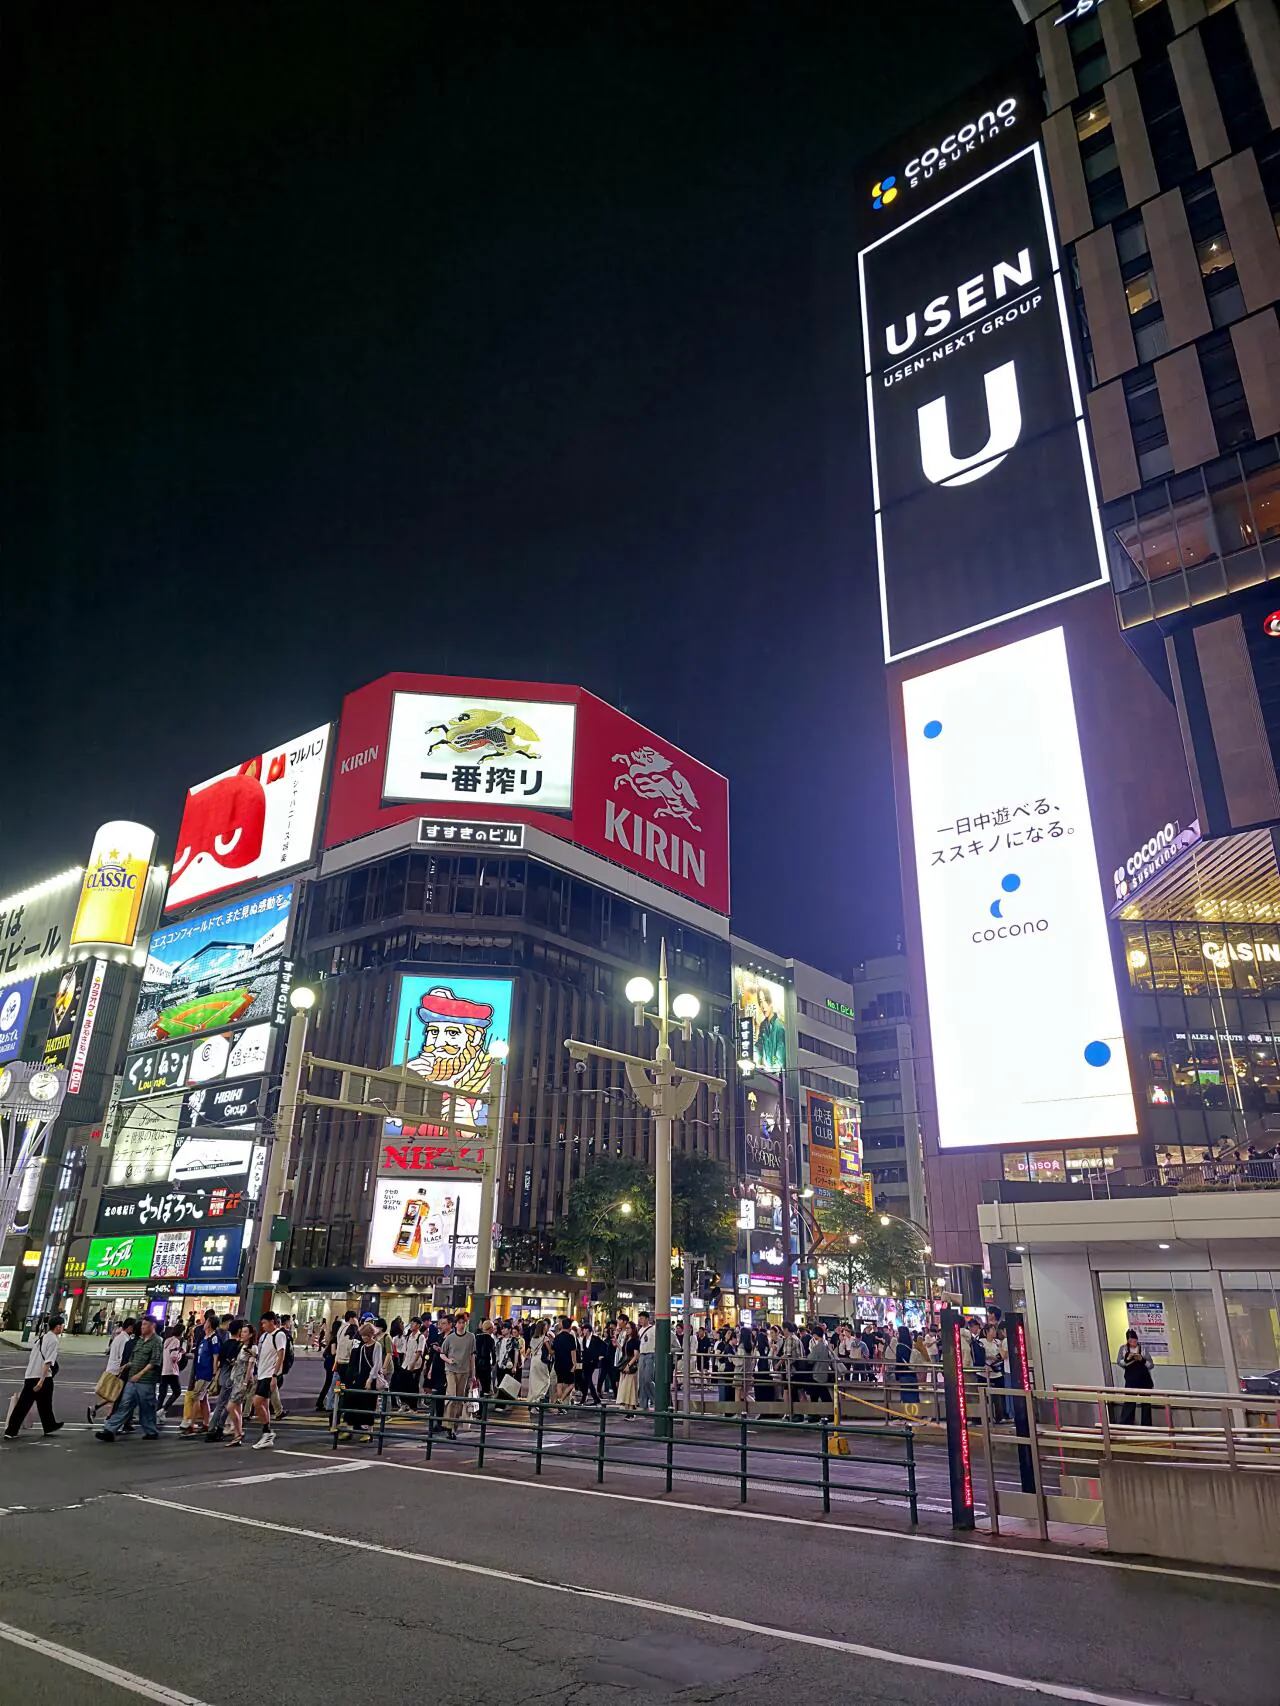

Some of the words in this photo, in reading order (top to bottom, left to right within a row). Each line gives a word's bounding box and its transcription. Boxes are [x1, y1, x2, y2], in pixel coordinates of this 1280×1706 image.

[885, 247, 1033, 356] USEN
[883, 331, 976, 388] USEN-NEXT
[981, 295, 1042, 335] GROUP
[290, 738, 324, 767] マルハン
[340, 744, 379, 775] KIRIN
[420, 764, 544, 796] 一番搾り
[937, 797, 1060, 835] 一日中遊べる、
[426, 824, 518, 842] すすきのビル
[604, 799, 705, 888] KIRIN
[930, 821, 1075, 867] ススキノになる。
[86, 871, 138, 890] CLASSIC
[971, 918, 1049, 944] cocono
[138, 1077, 167, 1091] Lounge
[213, 1087, 244, 1105] HIBIKI
[224, 1104, 248, 1117] Group
[814, 1108, 832, 1126] 快活
[815, 1126, 833, 1140] CLUB
[448, 1234, 479, 1245] BLAC
